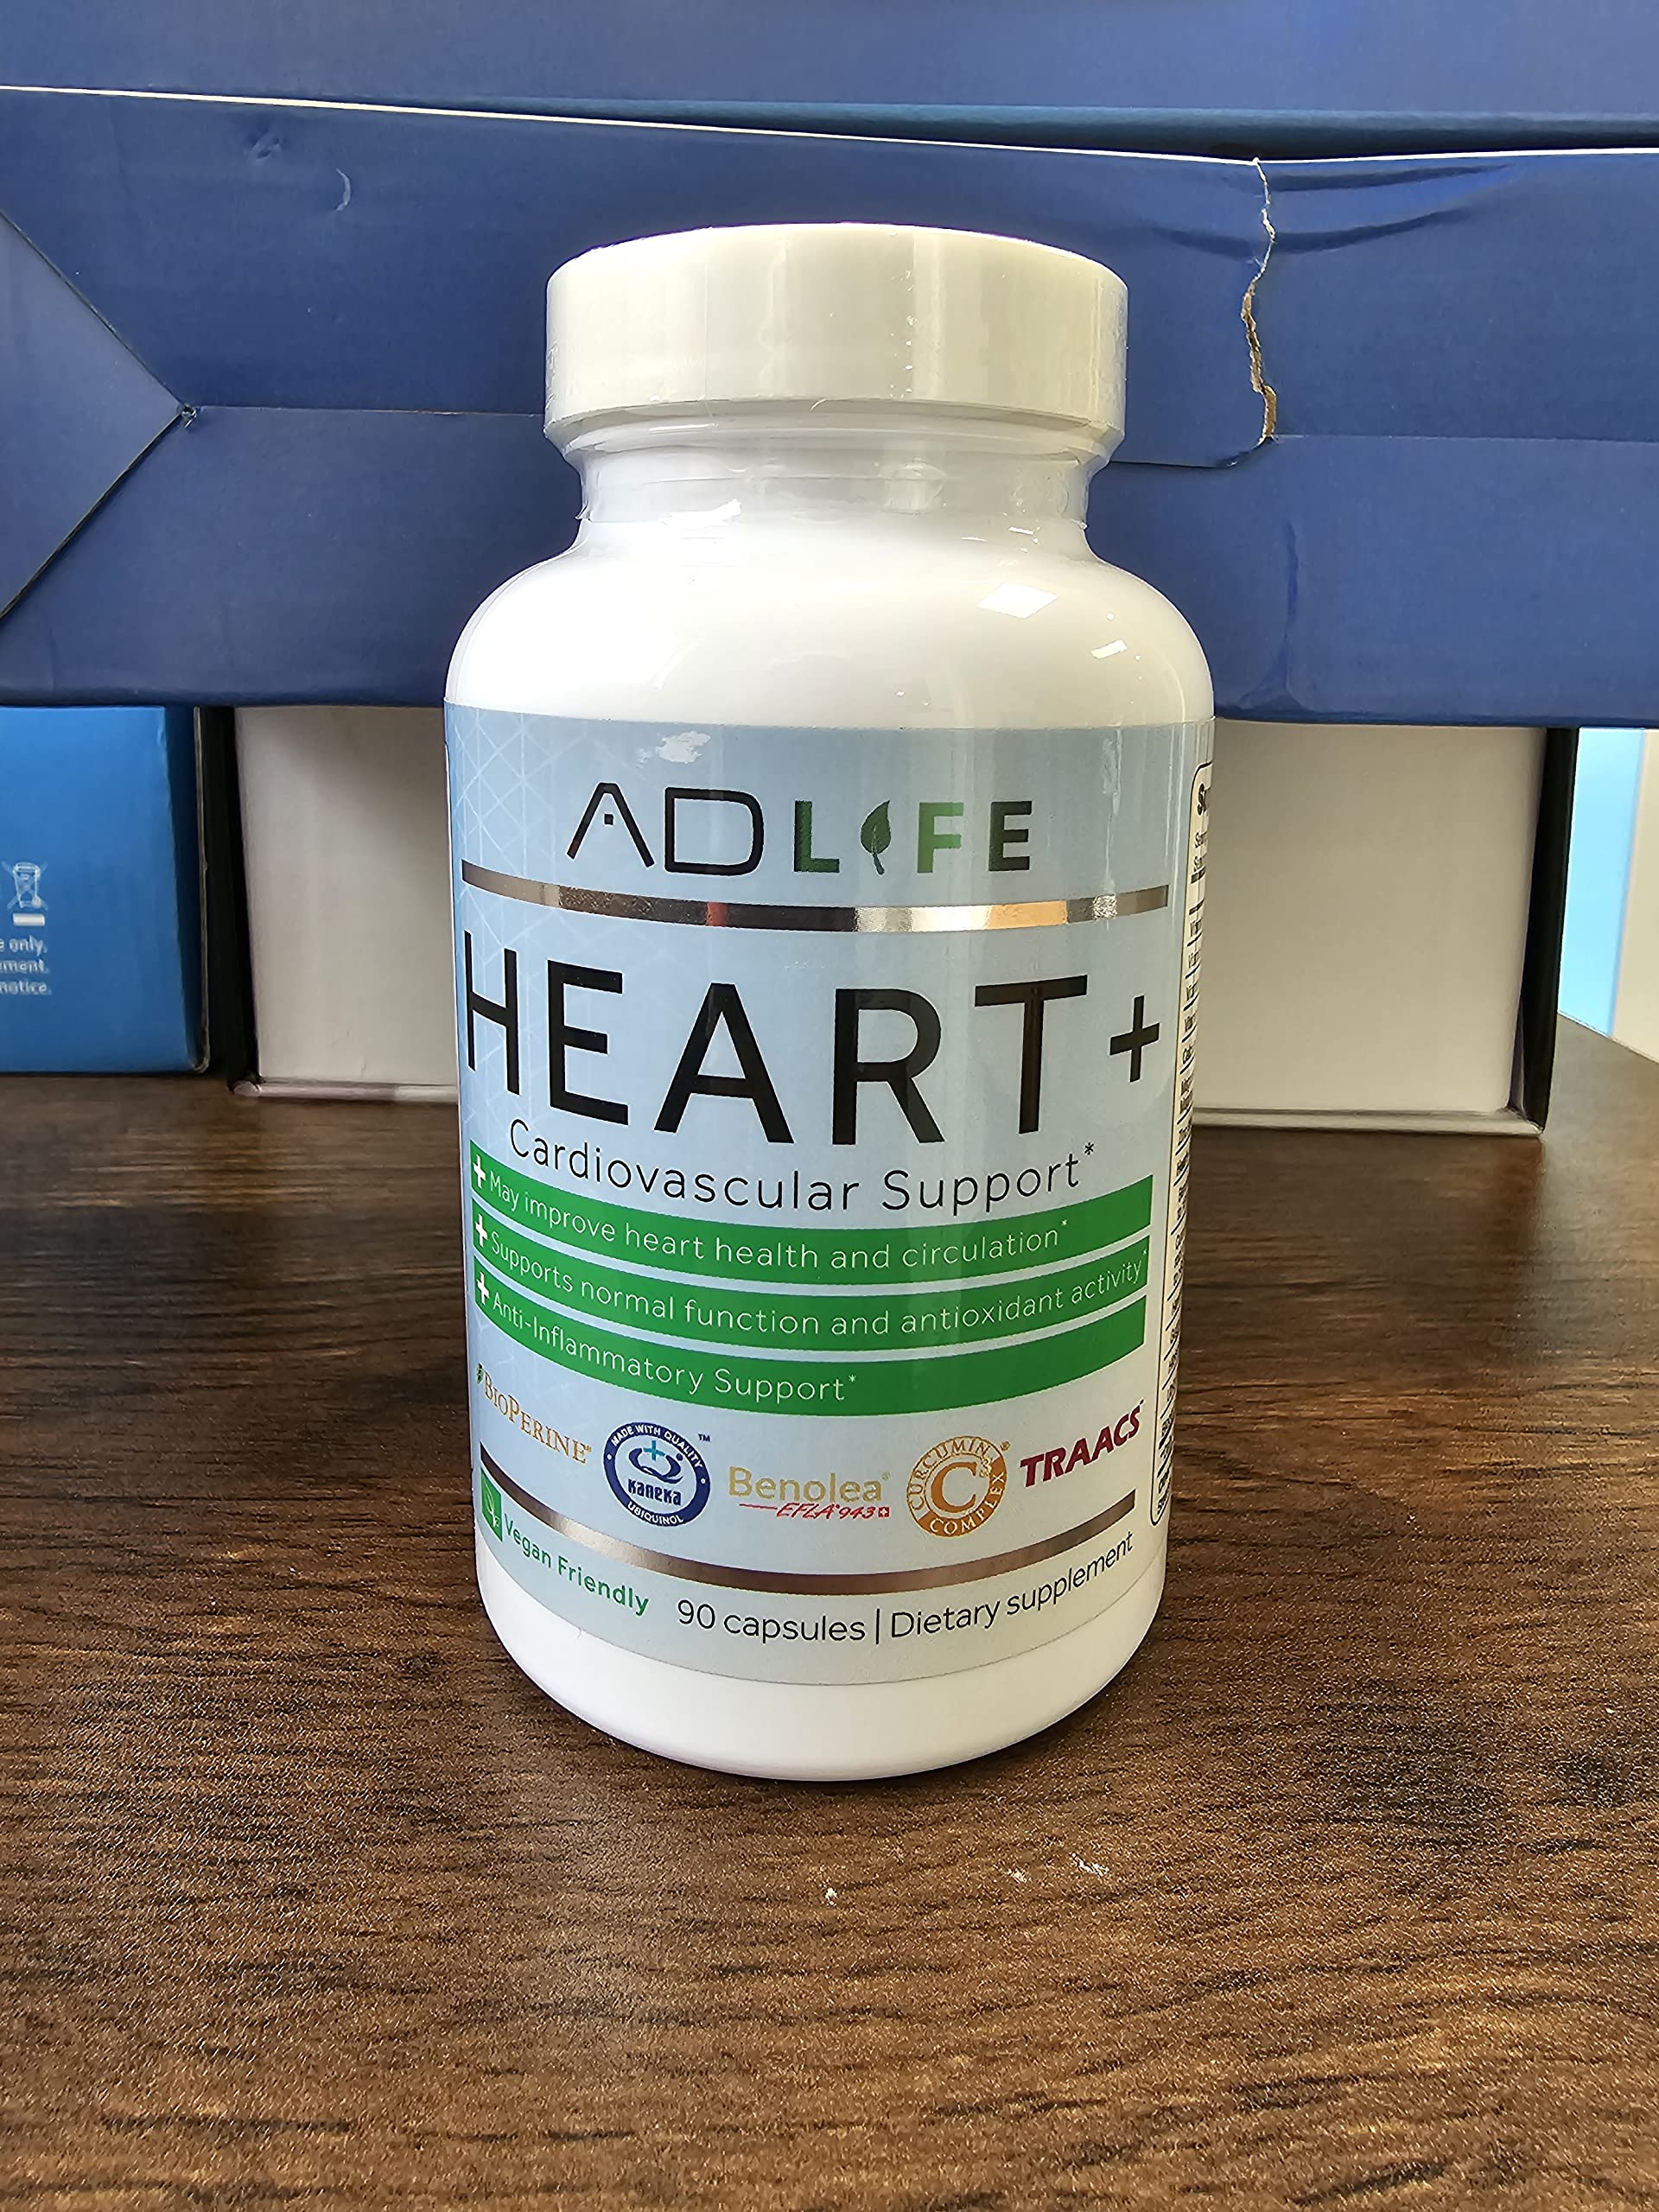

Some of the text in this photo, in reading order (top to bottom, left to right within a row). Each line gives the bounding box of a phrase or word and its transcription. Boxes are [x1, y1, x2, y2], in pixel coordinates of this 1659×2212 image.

[509, 1118, 859, 1211] Cardiovascular
[489, 1170, 519, 1212] May
[524, 1192, 616, 1243] improve
[626, 1222, 704, 1260] heart
[715, 1237, 818, 1268] health
[830, 1243, 890, 1269] and
[491, 1230, 574, 1294] Supports
[581, 1281, 674, 1320] normal
[684, 1300, 819, 1335] function
[830, 1309, 889, 1336] and
[900, 1288, 1064, 1332] antioxidant
[492, 1292, 704, 1395] Anti-Inflammatory
[611, 1424, 703, 1468] MADE WITH QUALITY
[909, 1438, 991, 1510] CURCUMIN
[627, 1501, 683, 1525] UBIQUINOL
[930, 1471, 1006, 1535] COMPLEX
[504, 1513, 650, 1617] Vegan Friendly
[677, 1530, 1134, 1643] 90 capsules Dietary supplement
